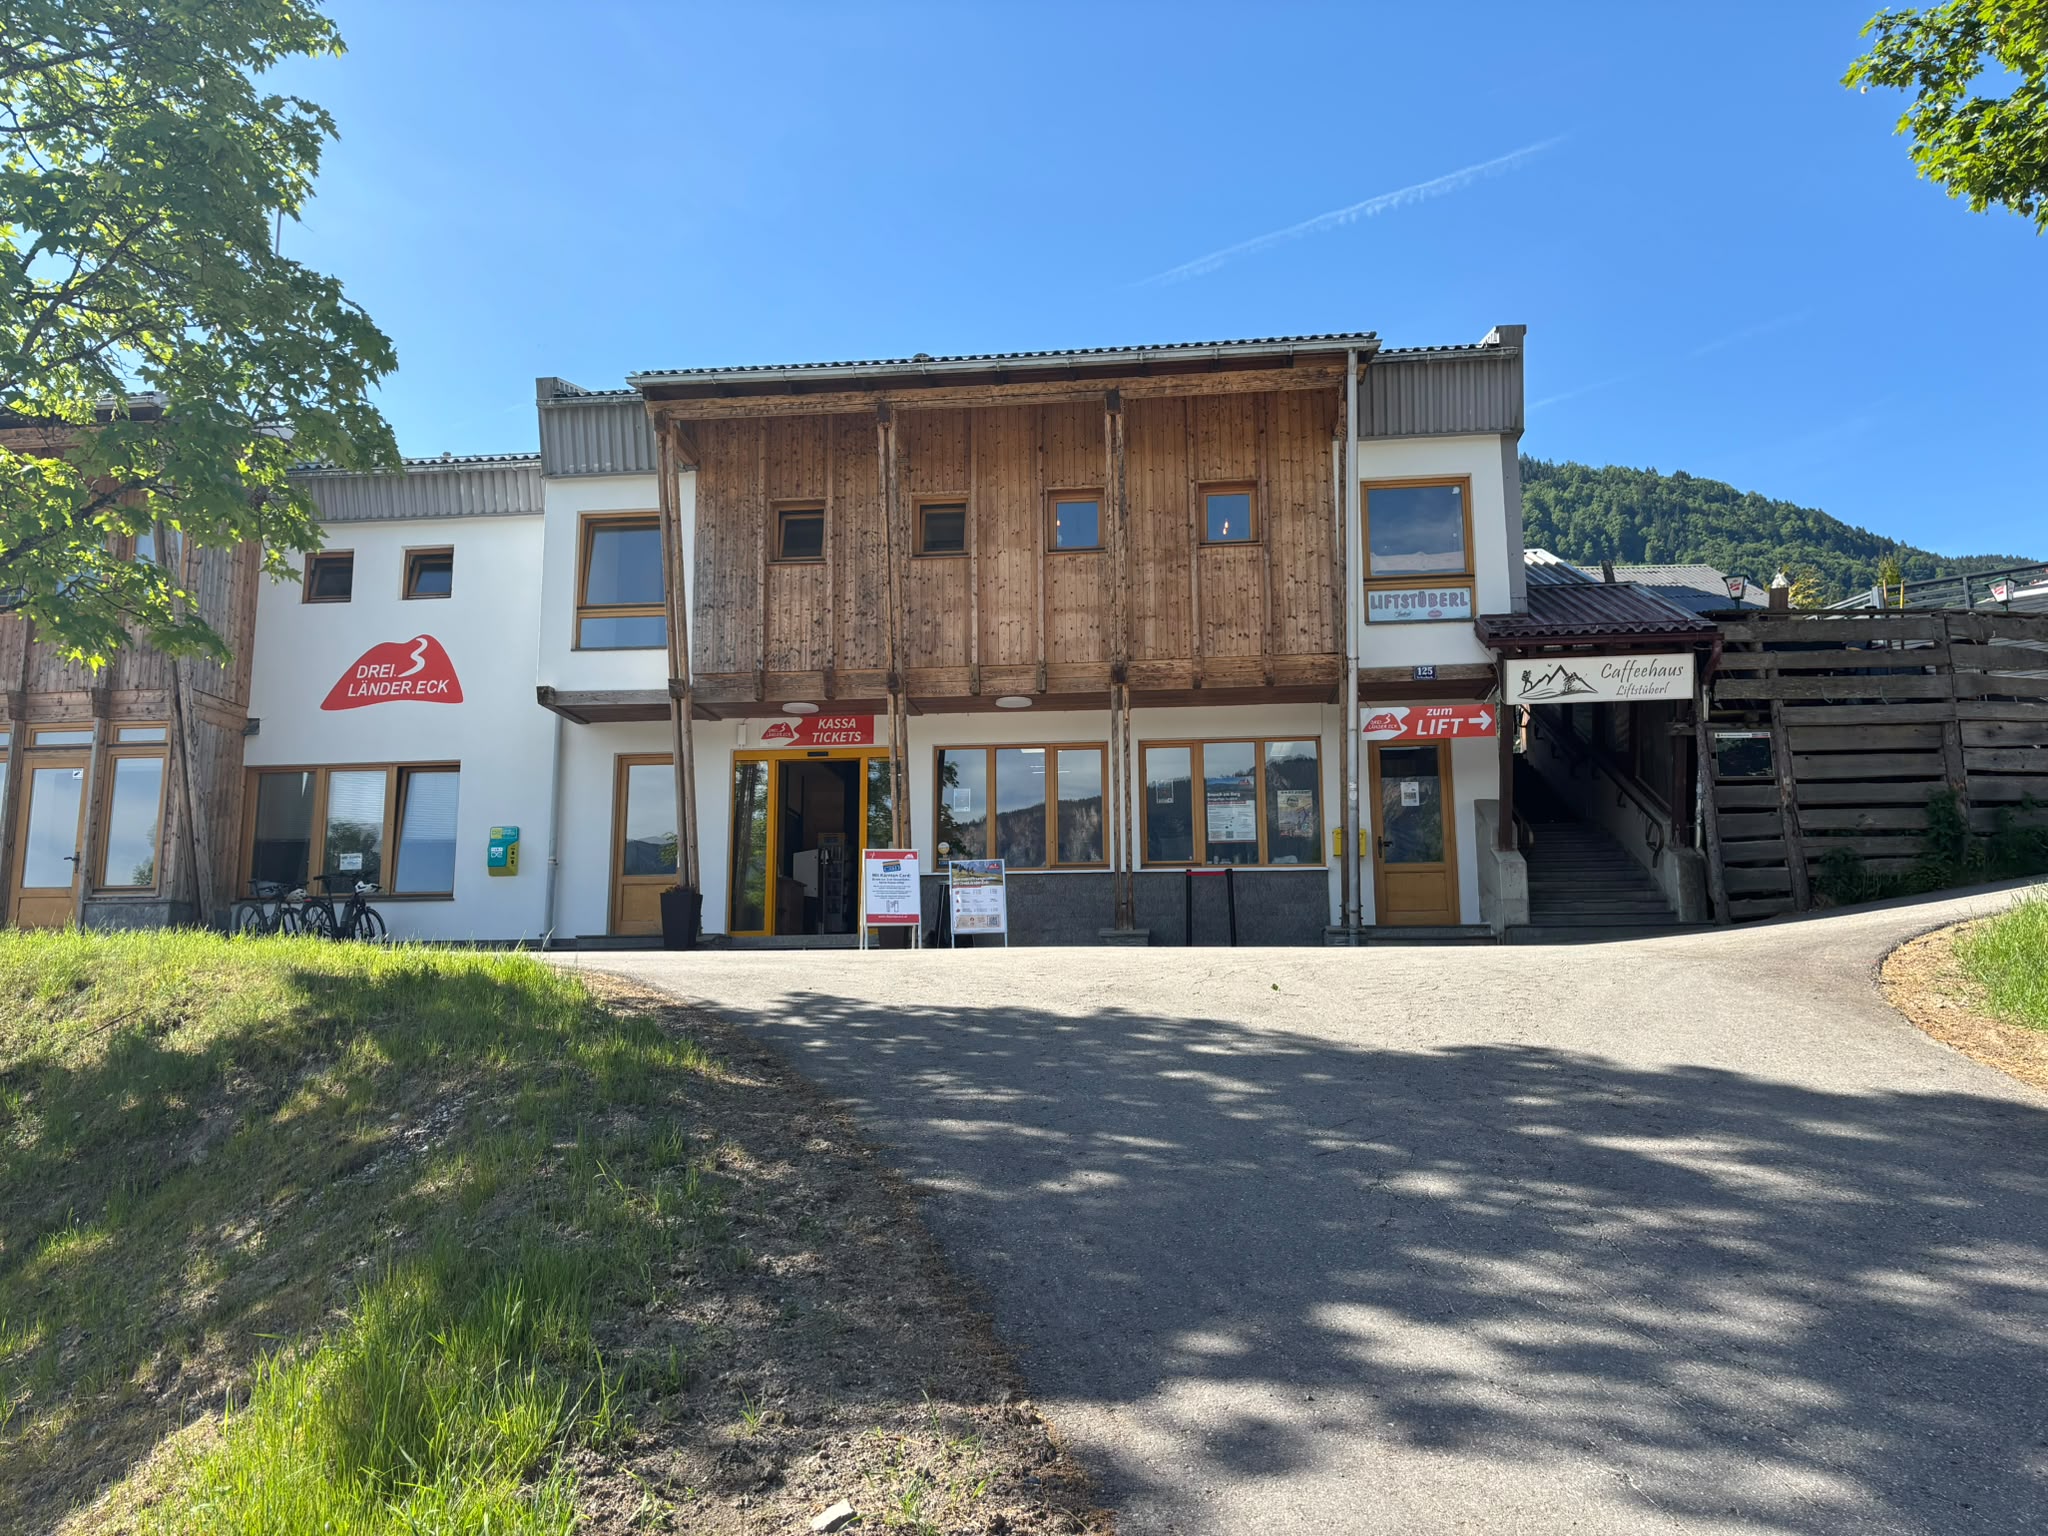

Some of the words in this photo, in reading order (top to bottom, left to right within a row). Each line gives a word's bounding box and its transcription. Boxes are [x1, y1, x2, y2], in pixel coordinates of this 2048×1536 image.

[1370, 591, 1468, 610] LIFTSTÜBERL
[356, 664, 397, 679] DREI.
[1417, 666, 1433, 676] 125
[1600, 658, 1684, 683] Caffeehaus
[347, 679, 450, 697] LÄNDER.ECK
[1615, 682, 1670, 698] Liftstüberl
[1426, 707, 1453, 717] zum
[818, 718, 857, 730] KASSA
[1416, 718, 1464, 736] LIFT
[812, 731, 862, 743] TICKETS
